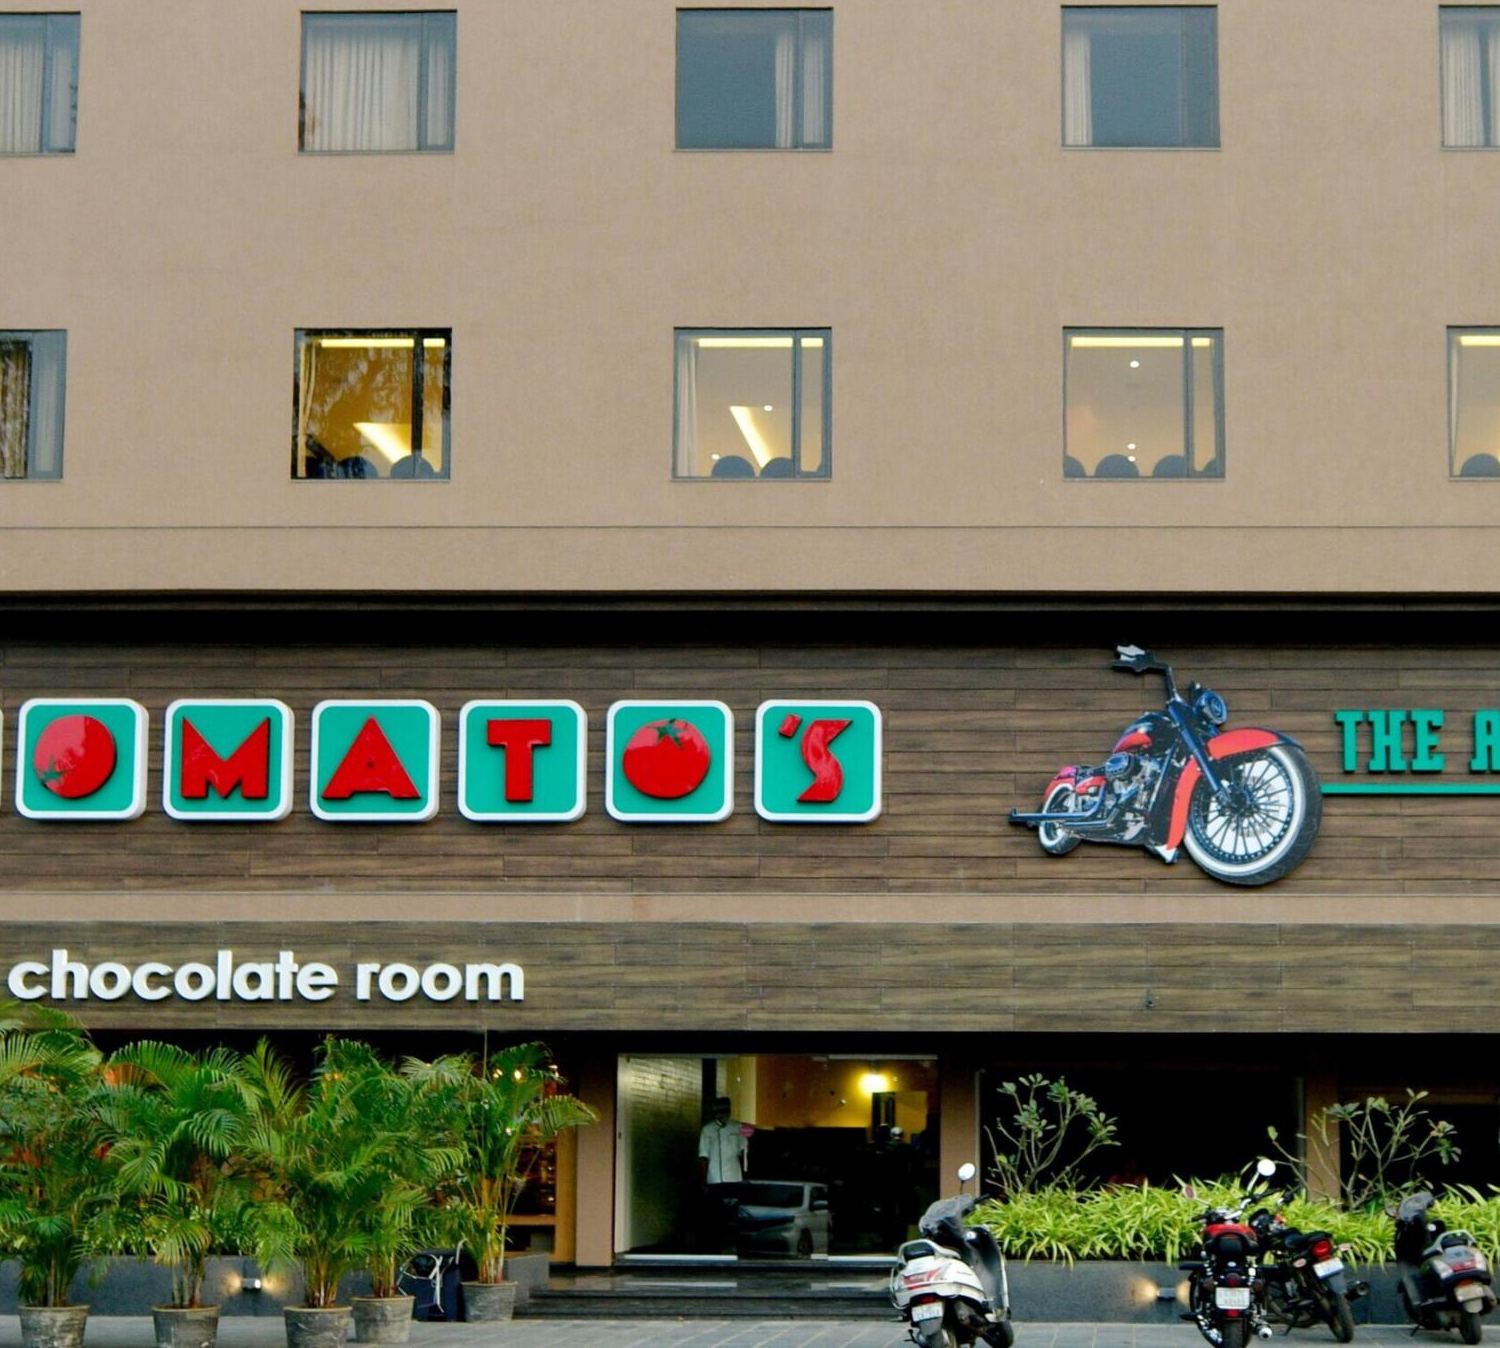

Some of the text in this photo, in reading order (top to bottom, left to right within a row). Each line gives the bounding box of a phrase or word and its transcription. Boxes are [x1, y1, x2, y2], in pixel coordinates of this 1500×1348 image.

[1334, 709, 1444, 773] THE
[7, 948, 338, 1001] chocolate
[355, 961, 525, 1001] room
